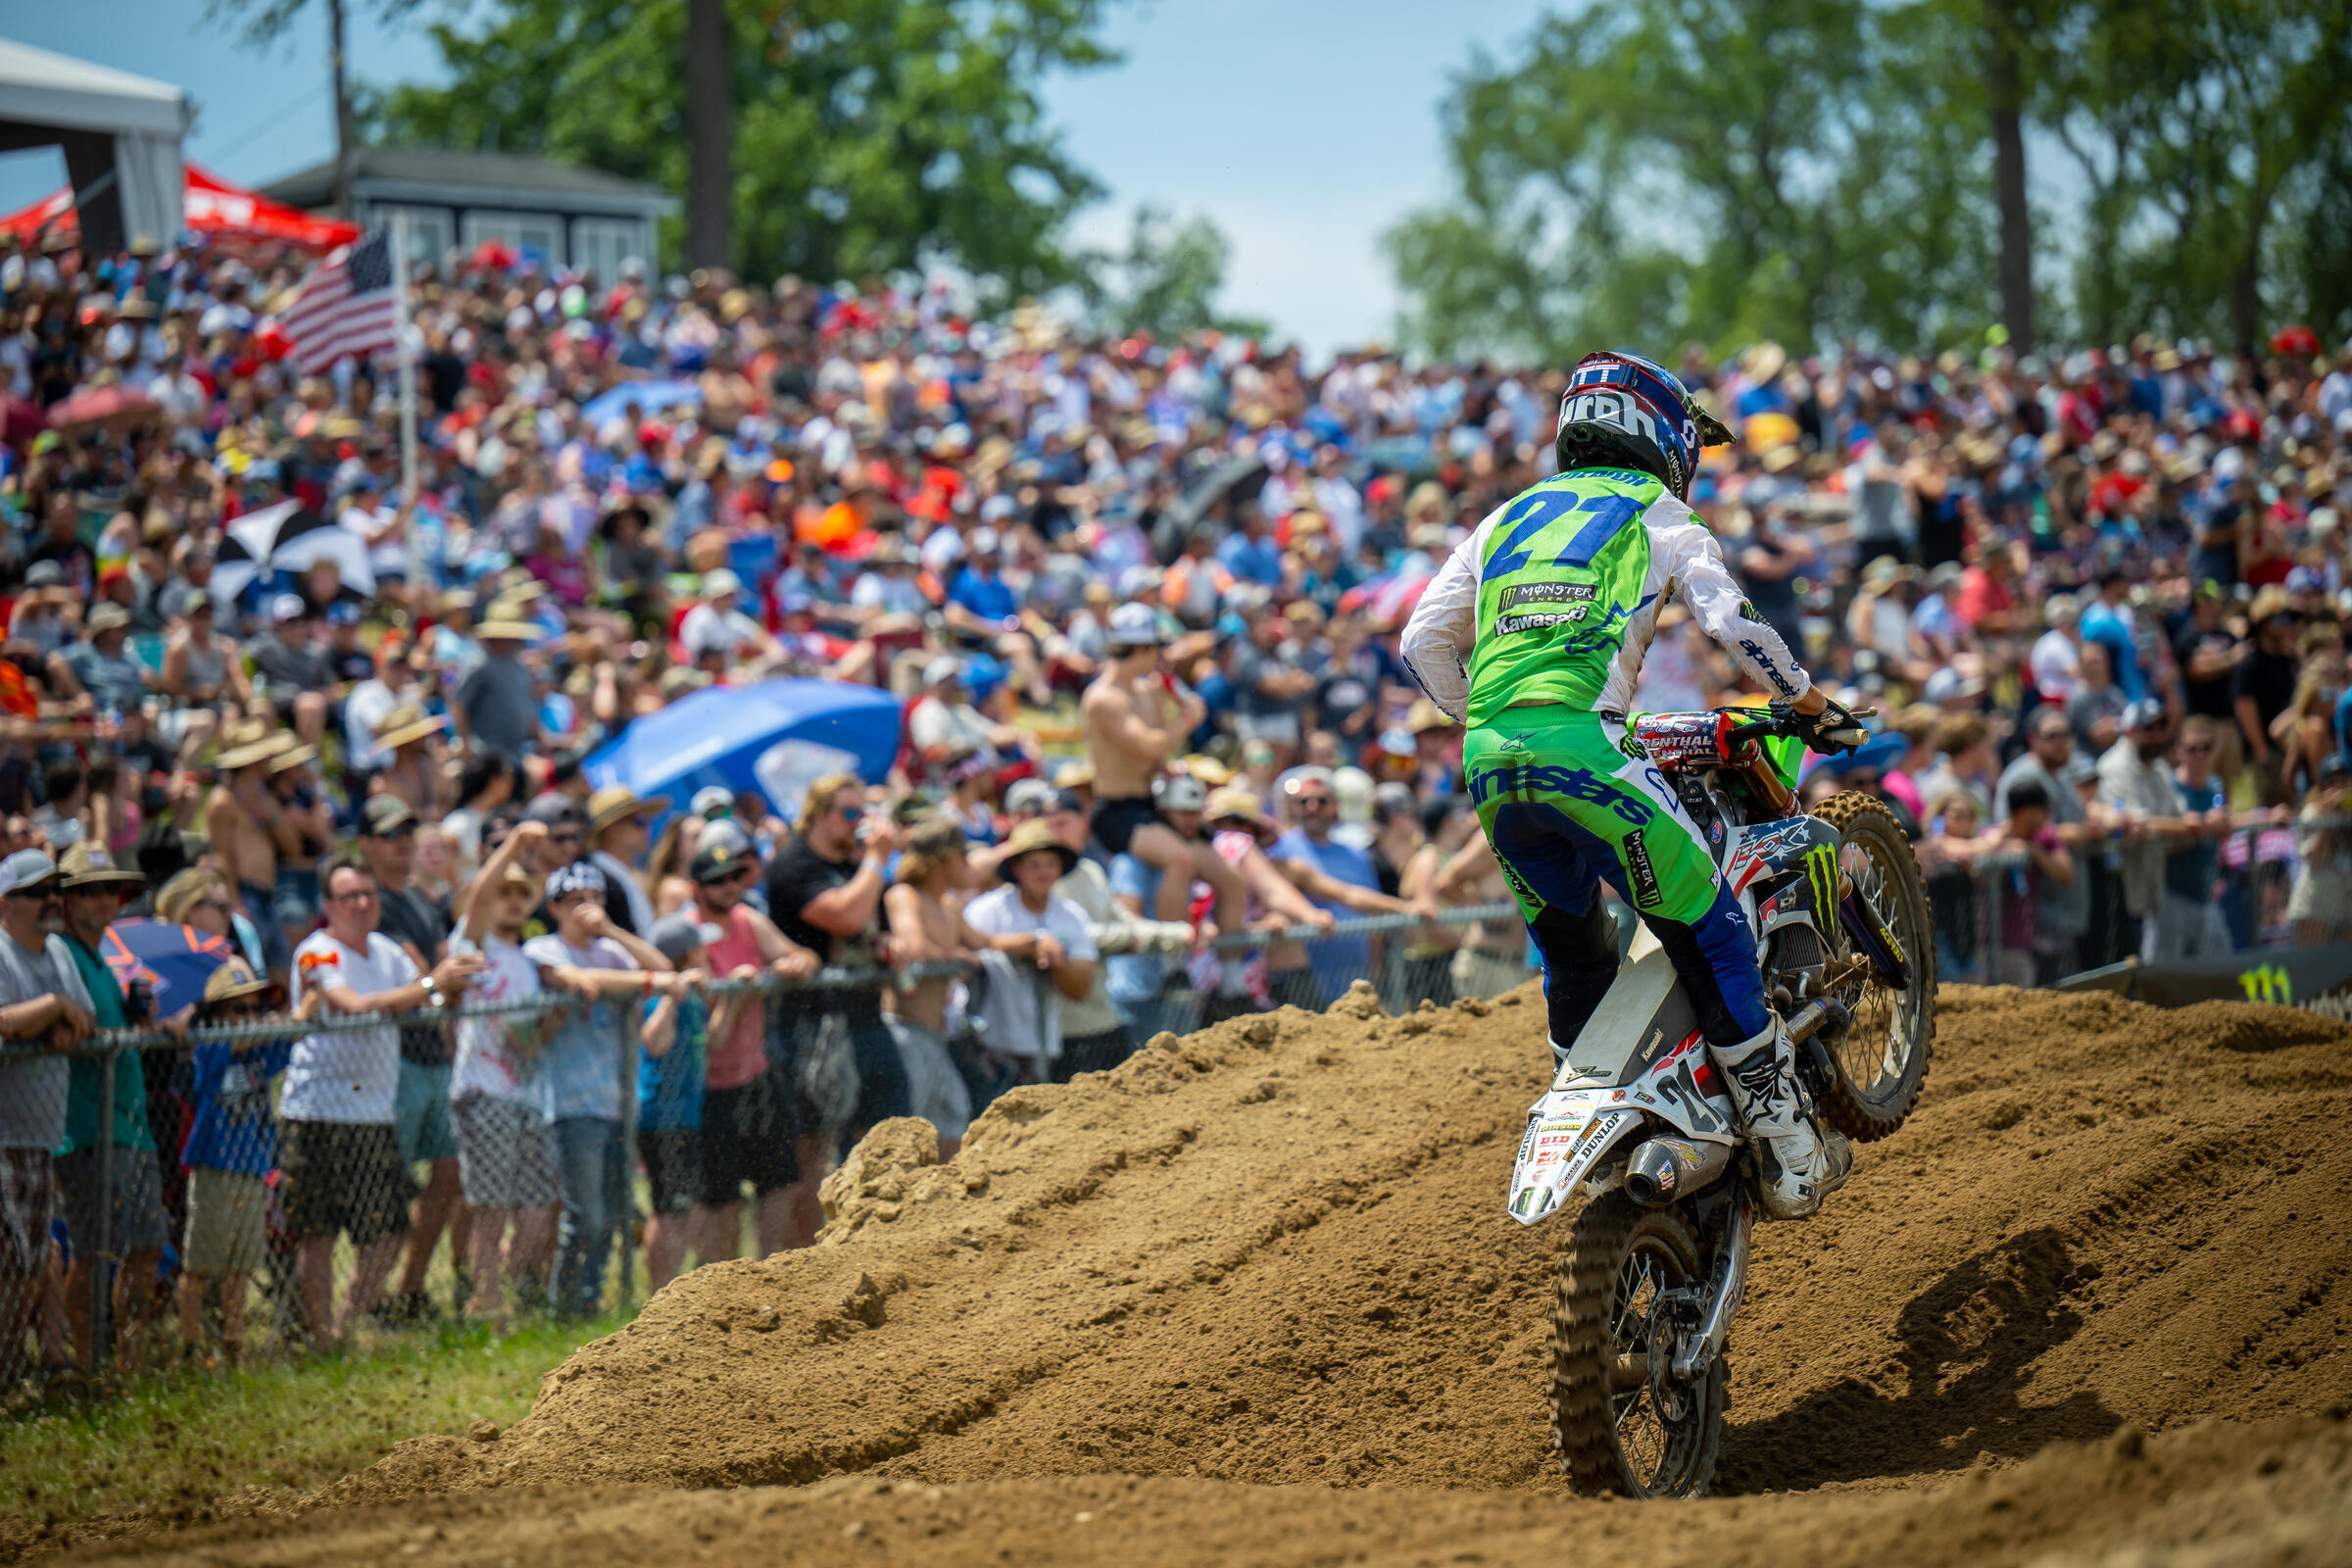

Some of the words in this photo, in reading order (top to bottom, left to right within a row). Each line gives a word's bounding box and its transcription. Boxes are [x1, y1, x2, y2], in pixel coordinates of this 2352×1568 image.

[1520, 584, 1592, 599] MONSTER
[1495, 606, 1588, 637] Kawasaki
[1581, 1112, 1620, 1158] DUNLOP
